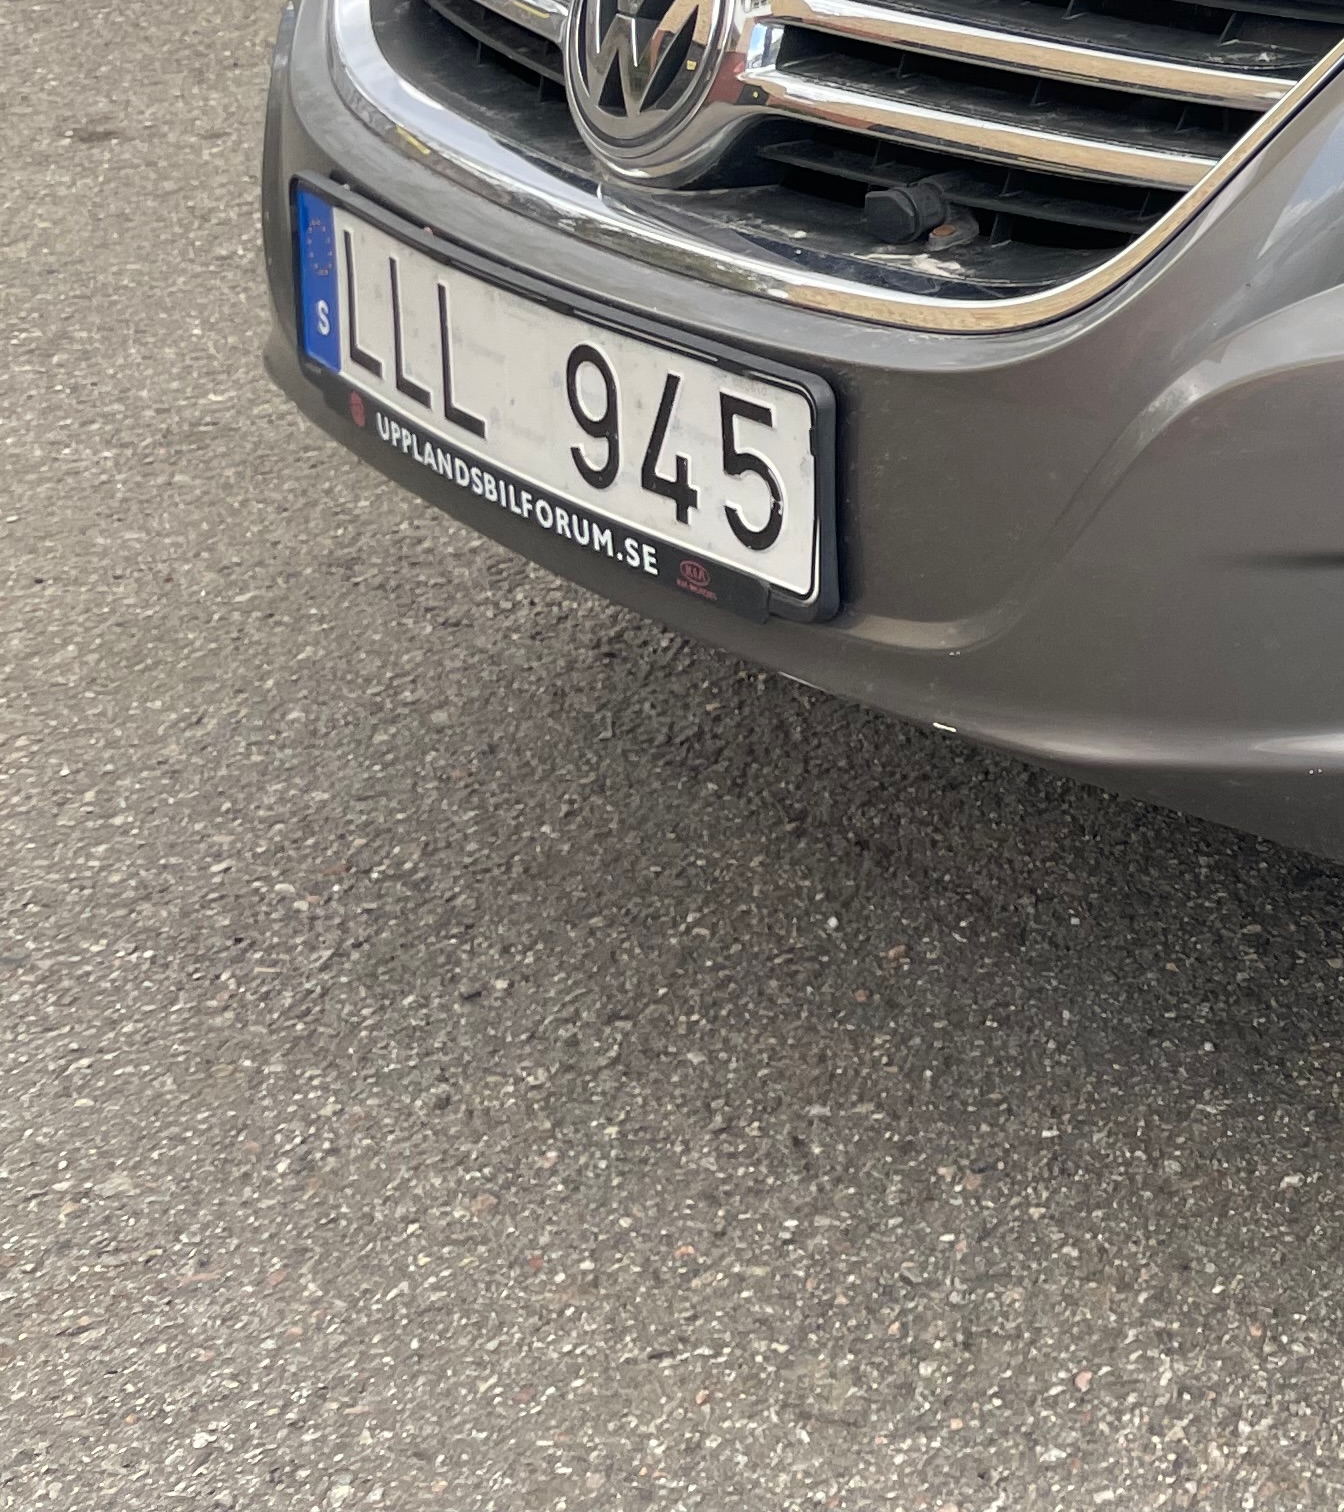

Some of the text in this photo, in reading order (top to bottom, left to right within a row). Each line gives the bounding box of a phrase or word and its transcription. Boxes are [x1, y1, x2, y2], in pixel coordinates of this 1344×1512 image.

[316, 299, 331, 336] S
[343, 228, 784, 552] LLL 945
[375, 410, 660, 576] UPPLANDSBILFORUM.SE
